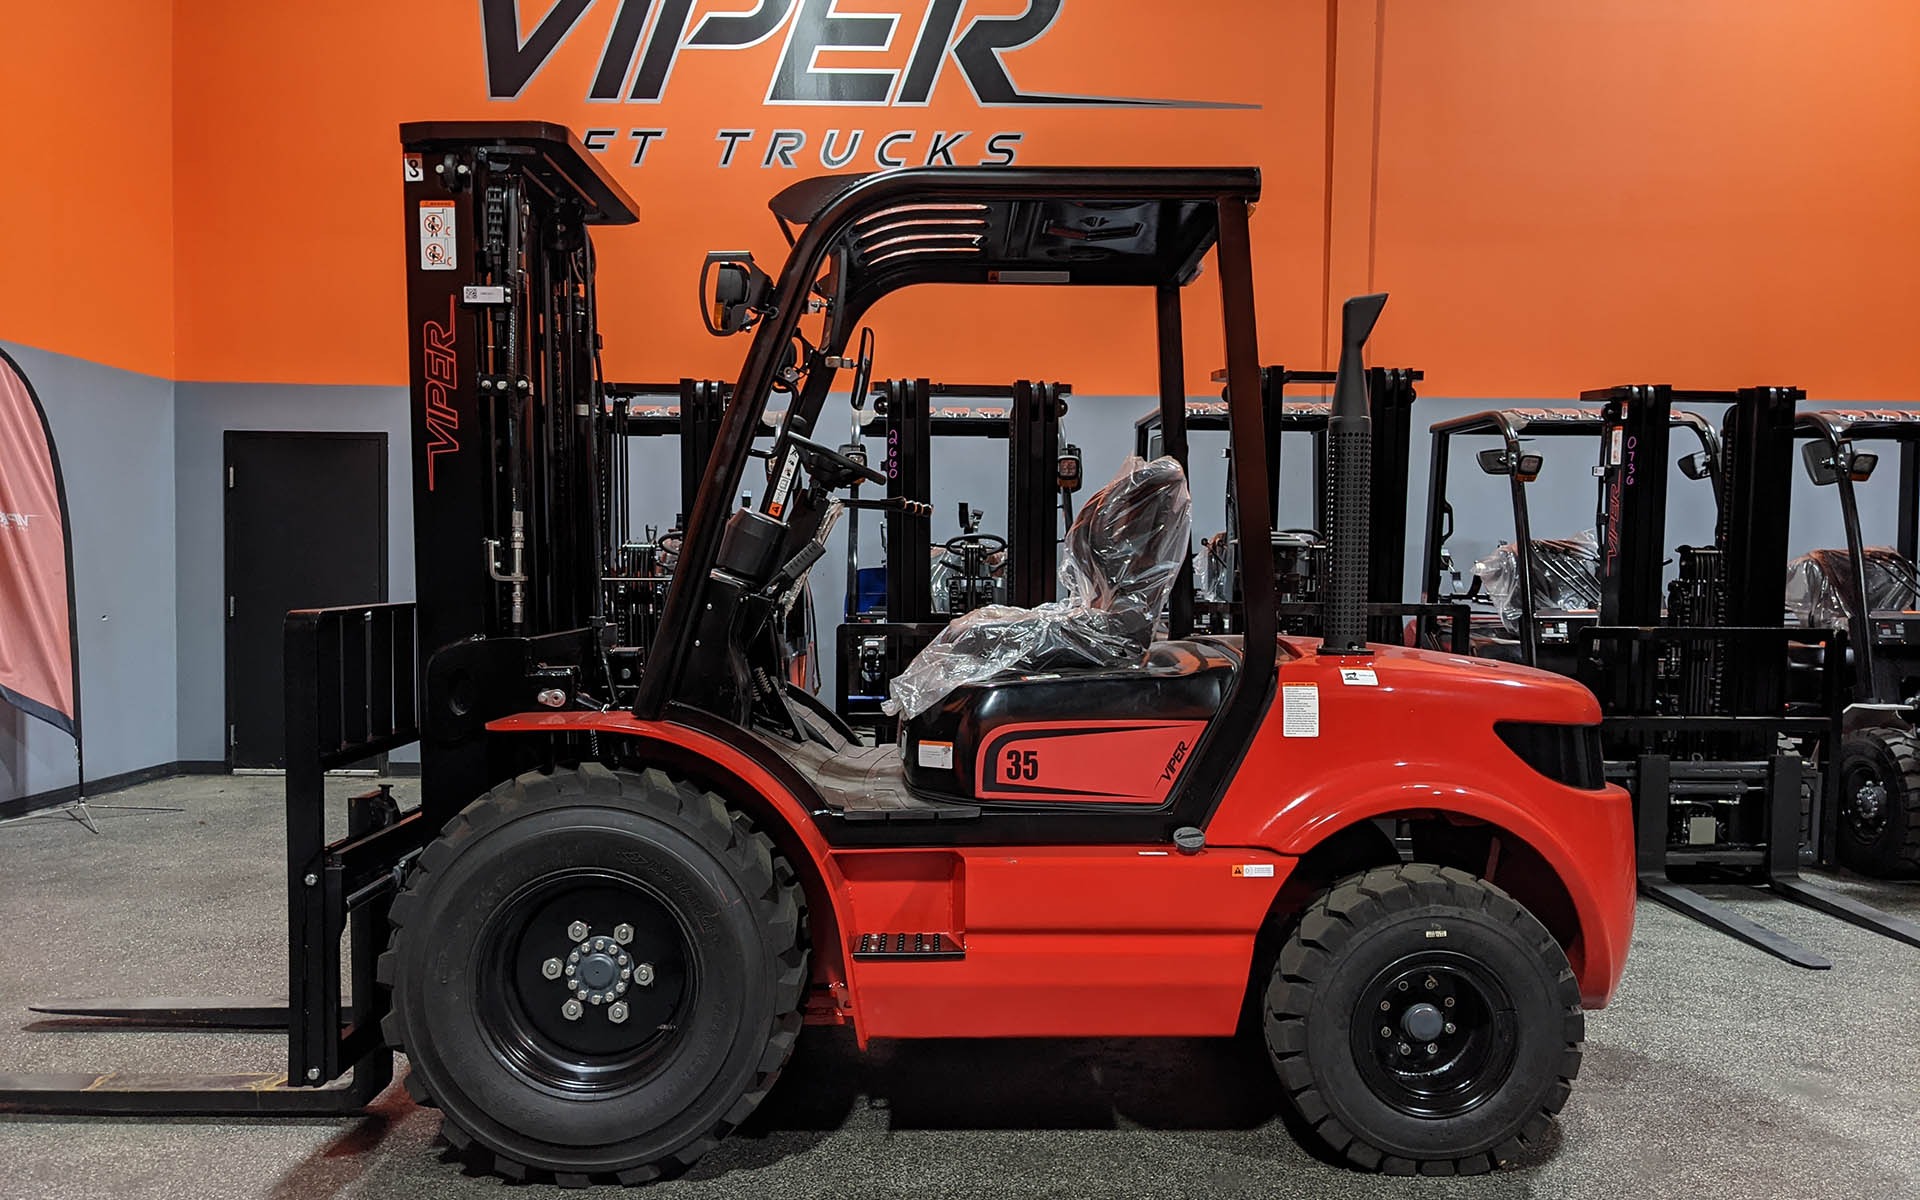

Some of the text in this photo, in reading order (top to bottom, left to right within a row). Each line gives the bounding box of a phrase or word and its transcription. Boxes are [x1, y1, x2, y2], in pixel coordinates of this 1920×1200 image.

[715, 128, 1024, 169] TRUCKS
[423, 294, 459, 491] VIPER
[1626, 437, 1637, 485] 0736
[1006, 750, 1039, 781] 35
[1157, 738, 1192, 785] VIPER
